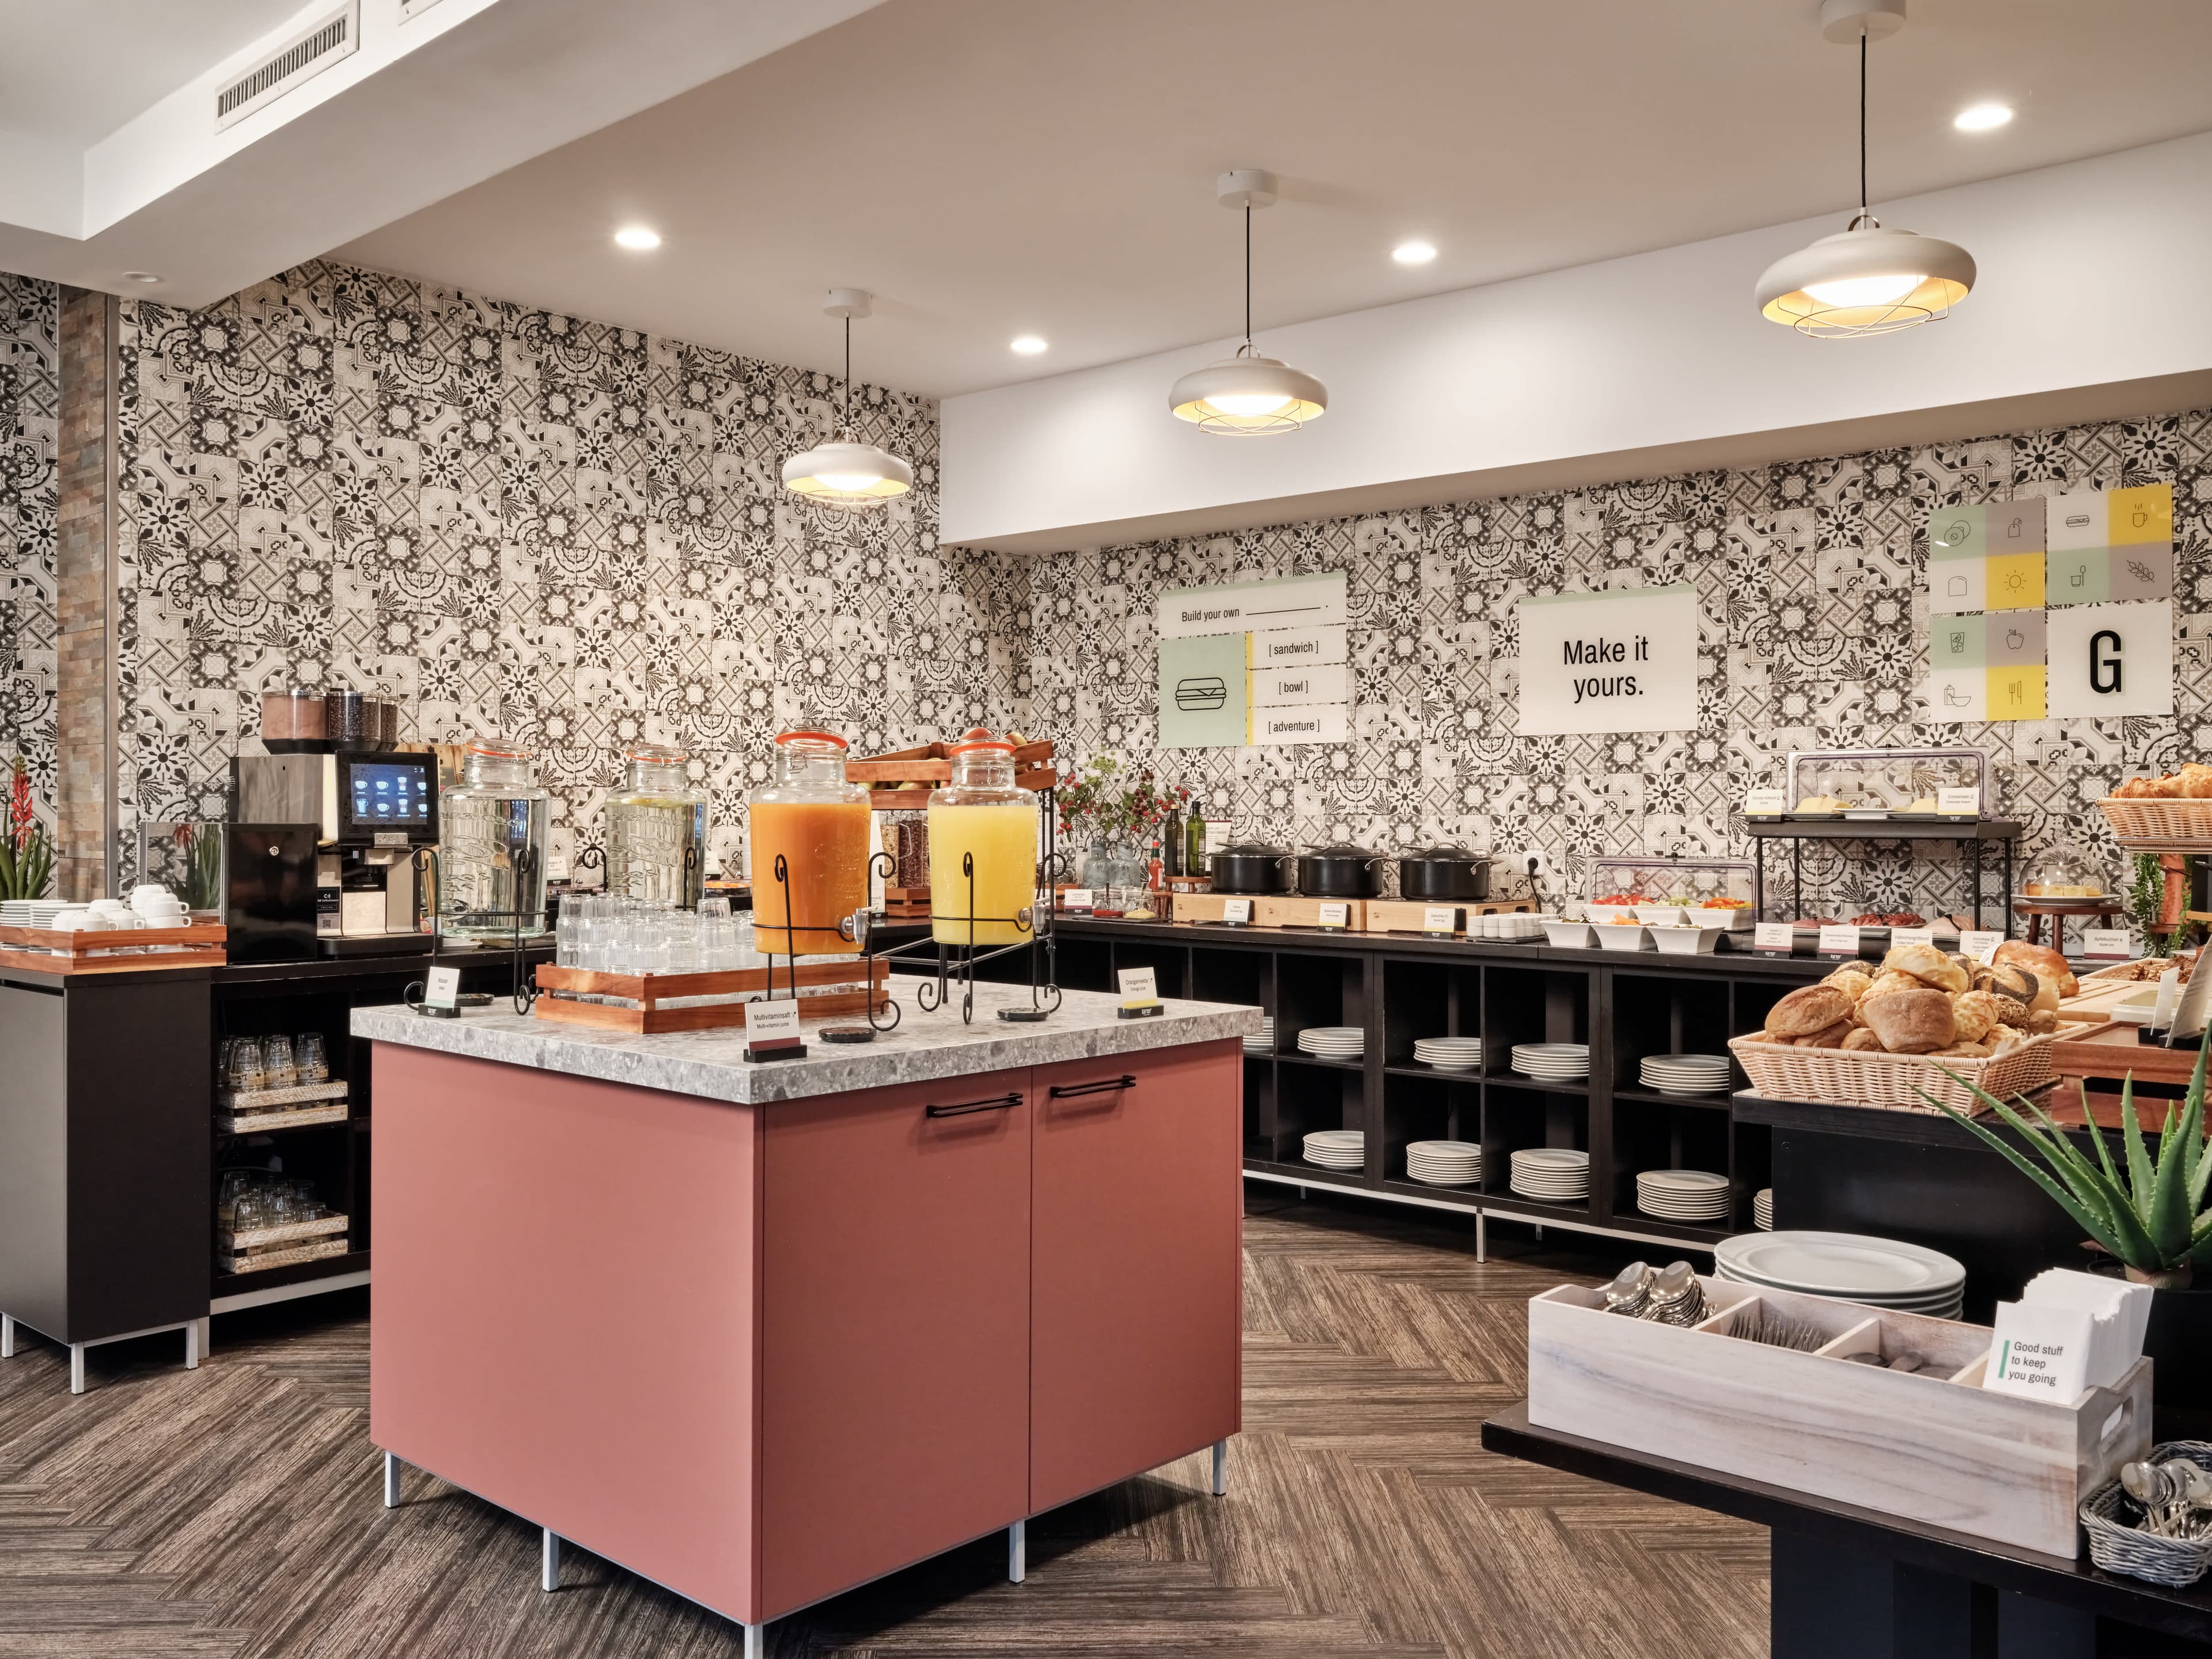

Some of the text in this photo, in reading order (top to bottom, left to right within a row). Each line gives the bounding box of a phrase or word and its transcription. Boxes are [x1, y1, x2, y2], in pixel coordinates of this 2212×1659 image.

[1181, 608, 1240, 622] Build your own
[1564, 635, 1648, 665] Make it
[2089, 630, 2122, 694] G
[1573, 676, 1643, 704] yours.
[754, 1011, 790, 1021] Multivitaminsaft
[2014, 1341, 2063, 1355] Good stuff
[2011, 1355, 2046, 1370] to keep
[2008, 1370, 2056, 1387] you going
